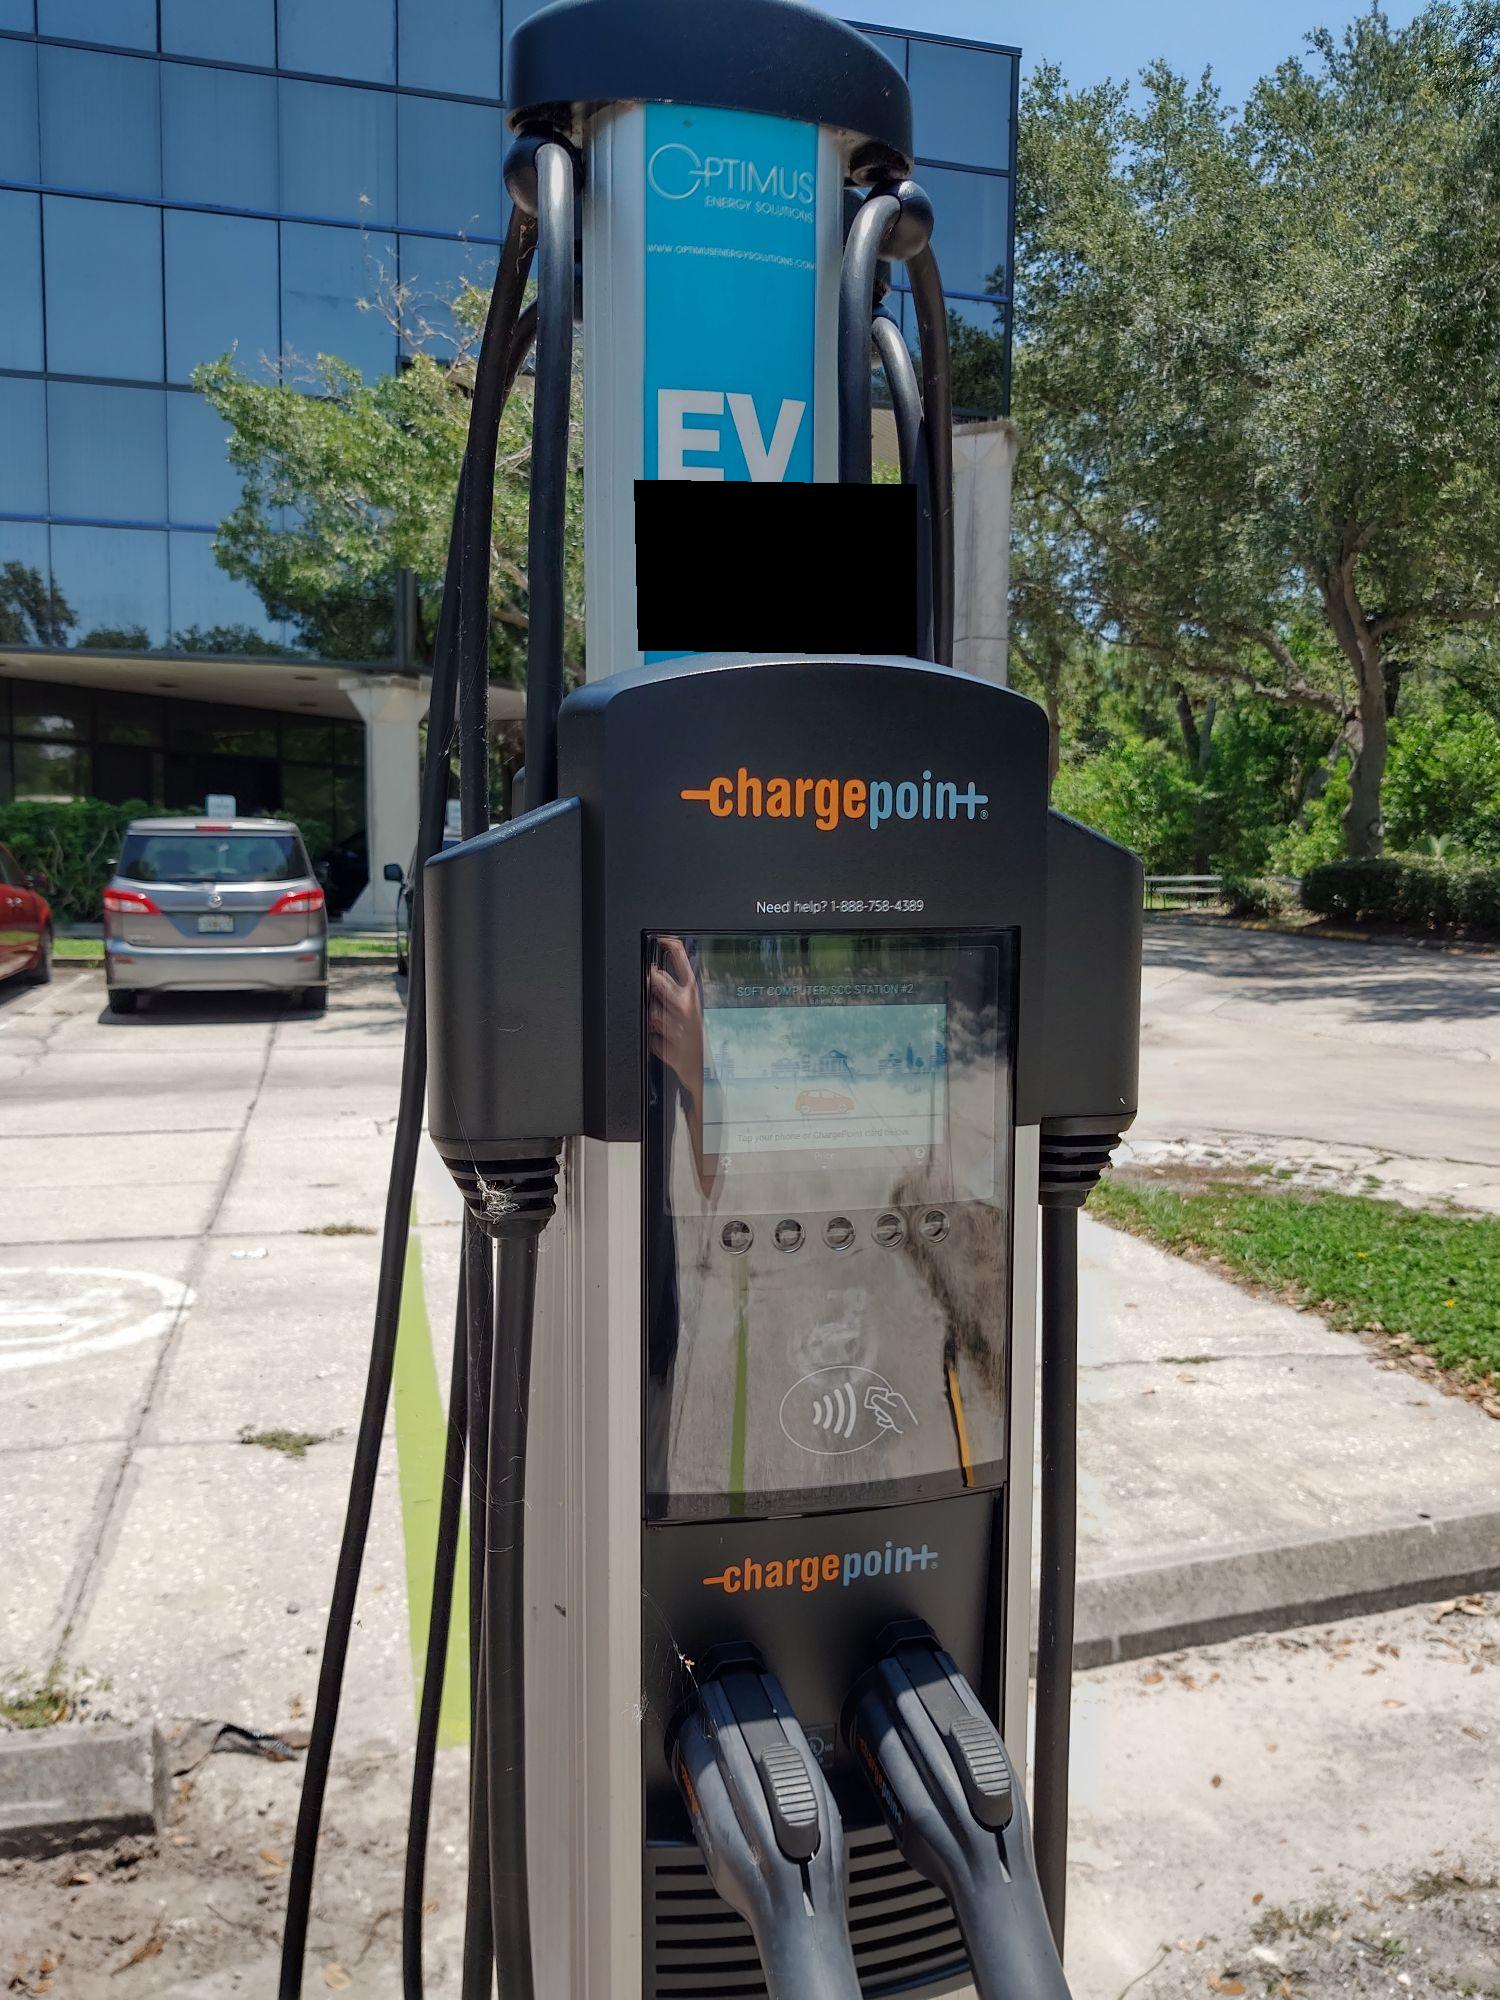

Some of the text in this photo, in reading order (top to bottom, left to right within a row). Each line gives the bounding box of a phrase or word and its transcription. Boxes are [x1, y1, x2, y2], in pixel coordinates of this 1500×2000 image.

[649, 143, 814, 204] OPTIMUS
[704, 195, 814, 224] ENERGY SOLUTIONS
[657, 388, 807, 483] EV
[756, 900, 925, 915] Need help? 1-888-758-4389
[855, 983, 899, 995] STATION
[901, 983, 914, 994] #2
